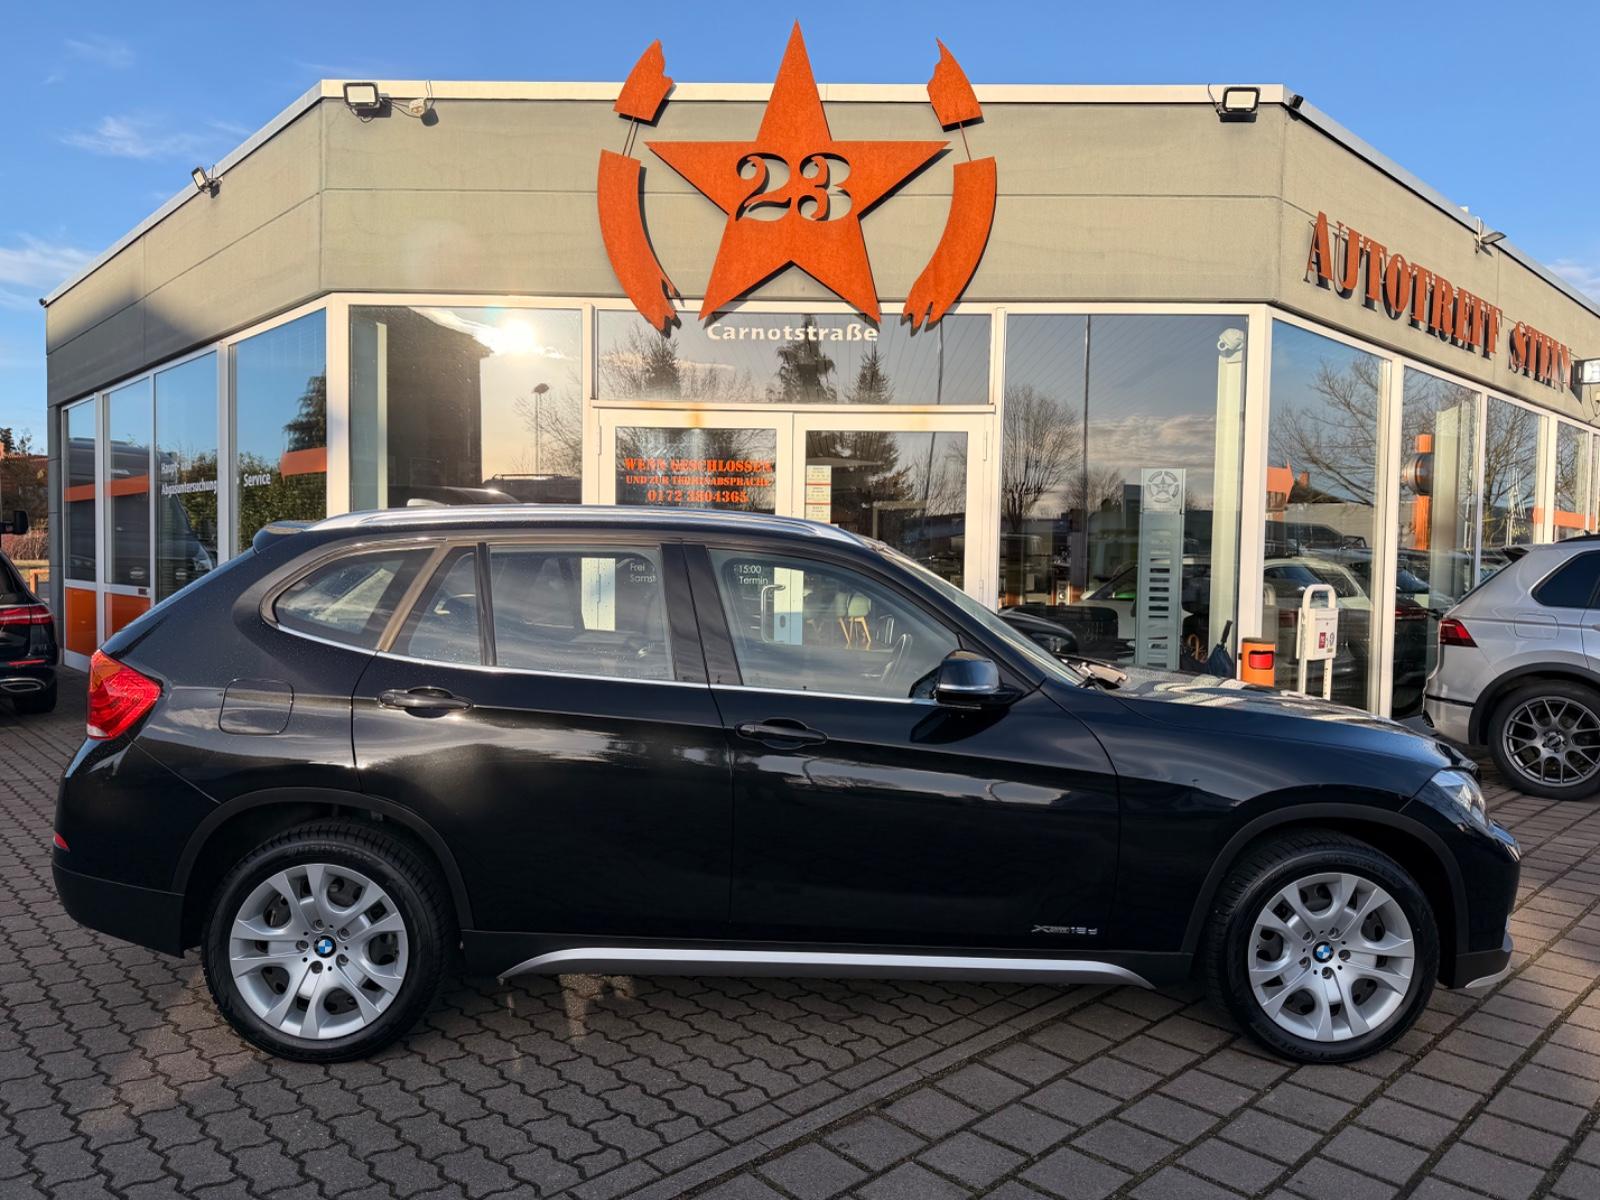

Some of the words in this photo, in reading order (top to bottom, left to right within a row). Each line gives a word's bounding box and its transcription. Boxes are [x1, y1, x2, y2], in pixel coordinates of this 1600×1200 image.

[736, 152, 852, 222] 23
[1303, 211, 1503, 353] AUTOTREFF
[706, 322, 879, 342] Carnotstraße
[243, 471, 271, 487] Service
[647, 489, 683, 503] 0172
